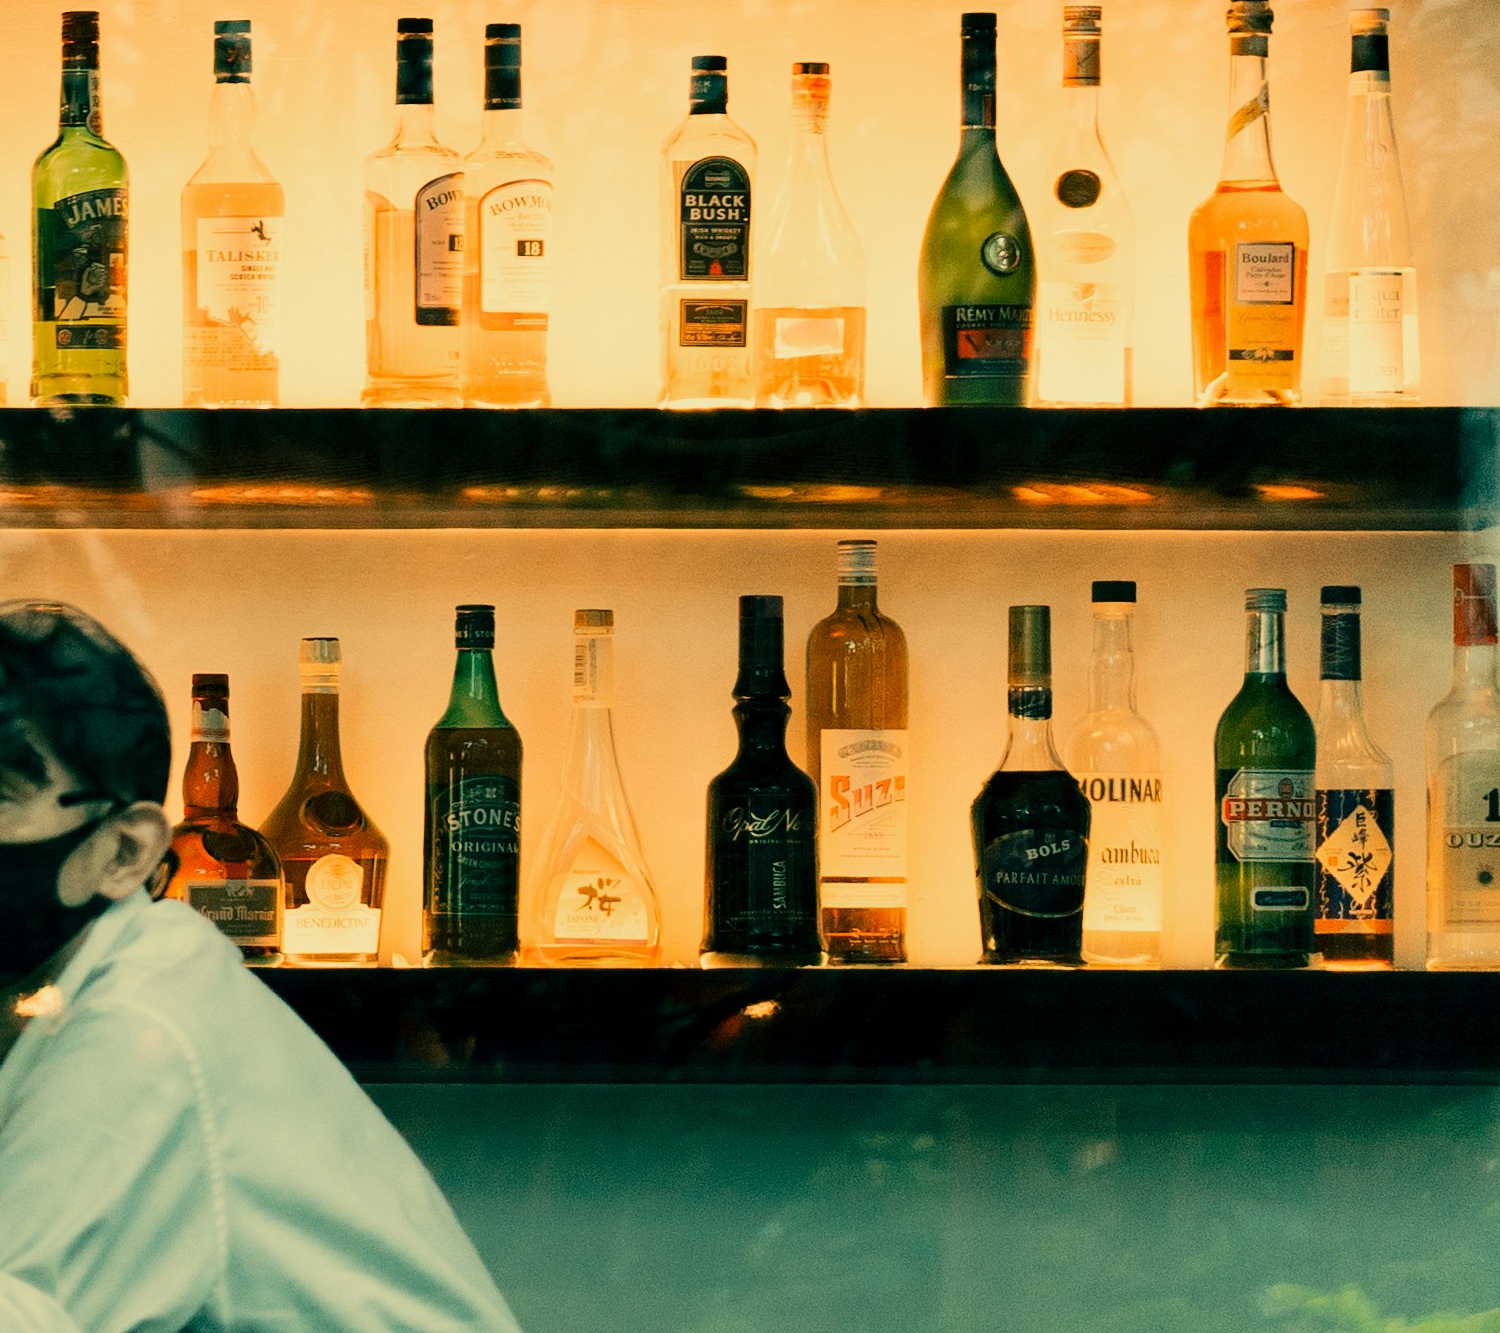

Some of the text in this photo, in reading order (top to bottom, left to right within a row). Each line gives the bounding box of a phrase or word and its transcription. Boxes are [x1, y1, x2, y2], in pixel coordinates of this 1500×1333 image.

[684, 193, 746, 208] BLACK
[689, 207, 740, 221] BUSH
[523, 240, 541, 256] 18
[205, 249, 281, 263] TALISKER
[1241, 251, 1290, 265] Boulard
[955, 306, 995, 323] RÉMY
[1048, 307, 1117, 326] Hennessy
[1227, 799, 1315, 818] PERNO
[721, 806, 780, 842] Opal
[451, 841, 519, 854] ORIGINAL
[1445, 833, 1500, 848] OUZ
[1025, 838, 1071, 862] BOLS
[771, 859, 787, 910] SAMBUCA
[995, 871, 1048, 886] PARFAIT
[1113, 873, 1143, 886] extra
